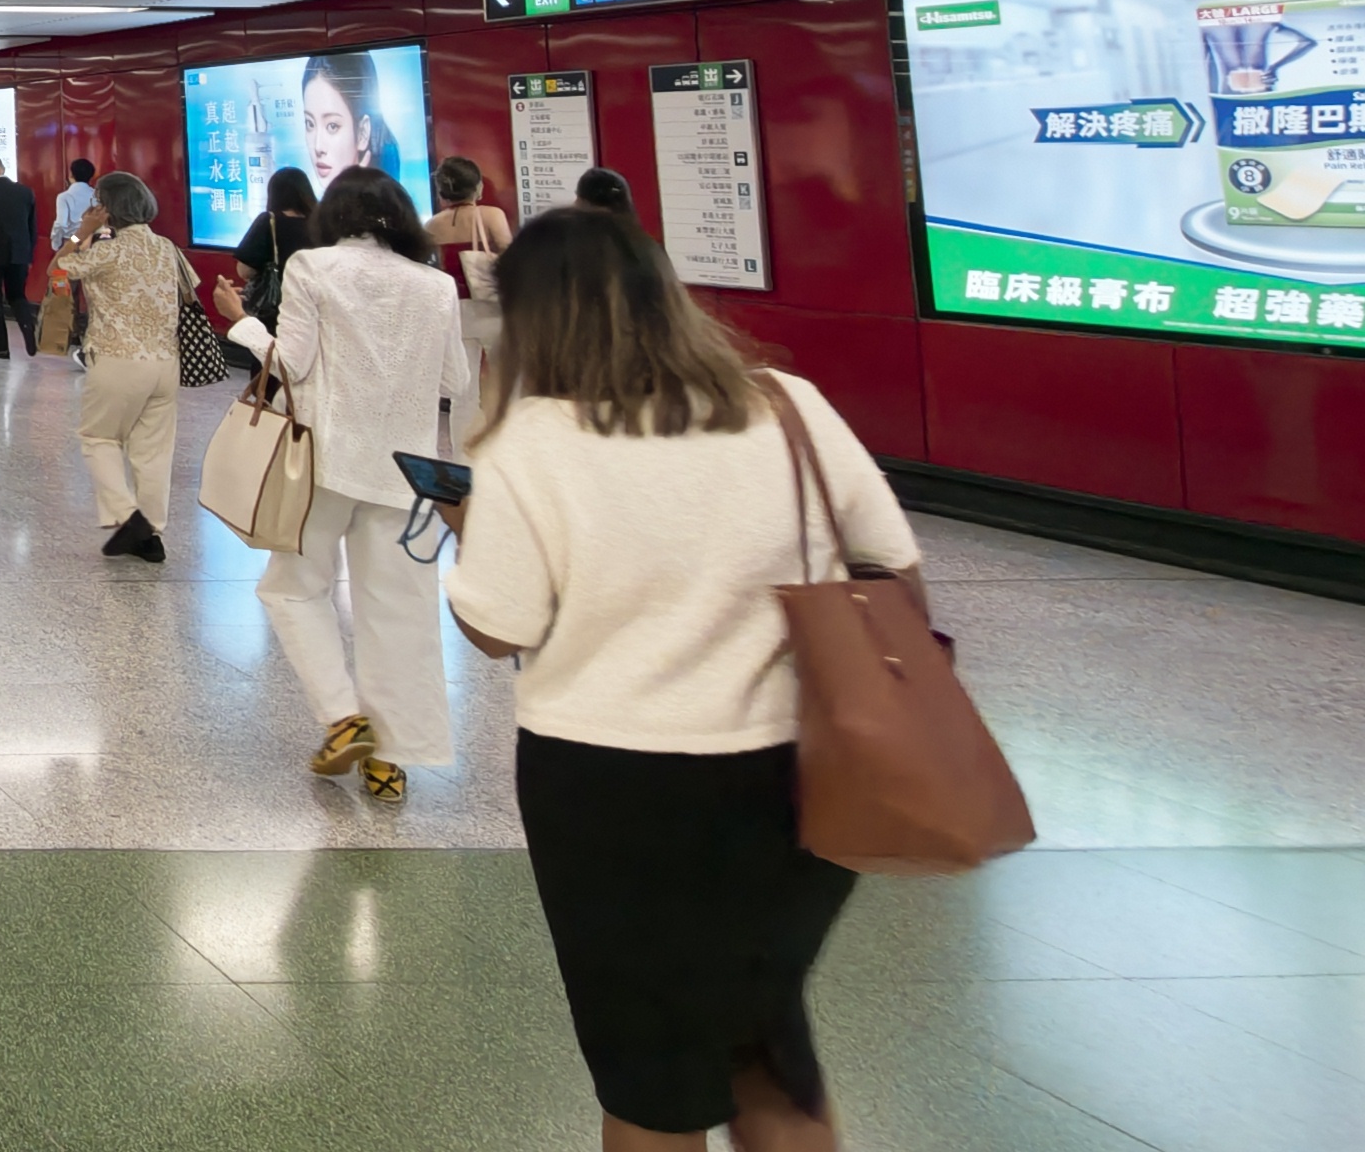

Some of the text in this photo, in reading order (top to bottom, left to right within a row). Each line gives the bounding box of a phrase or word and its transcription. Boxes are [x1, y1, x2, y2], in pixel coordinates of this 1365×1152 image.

[1045, 110, 1174, 138] 解決疼痛
[221, 100, 244, 212] 超越表面
[965, 269, 1175, 314] 臨床級膏布
[1212, 286, 1365, 329] 超強藥
